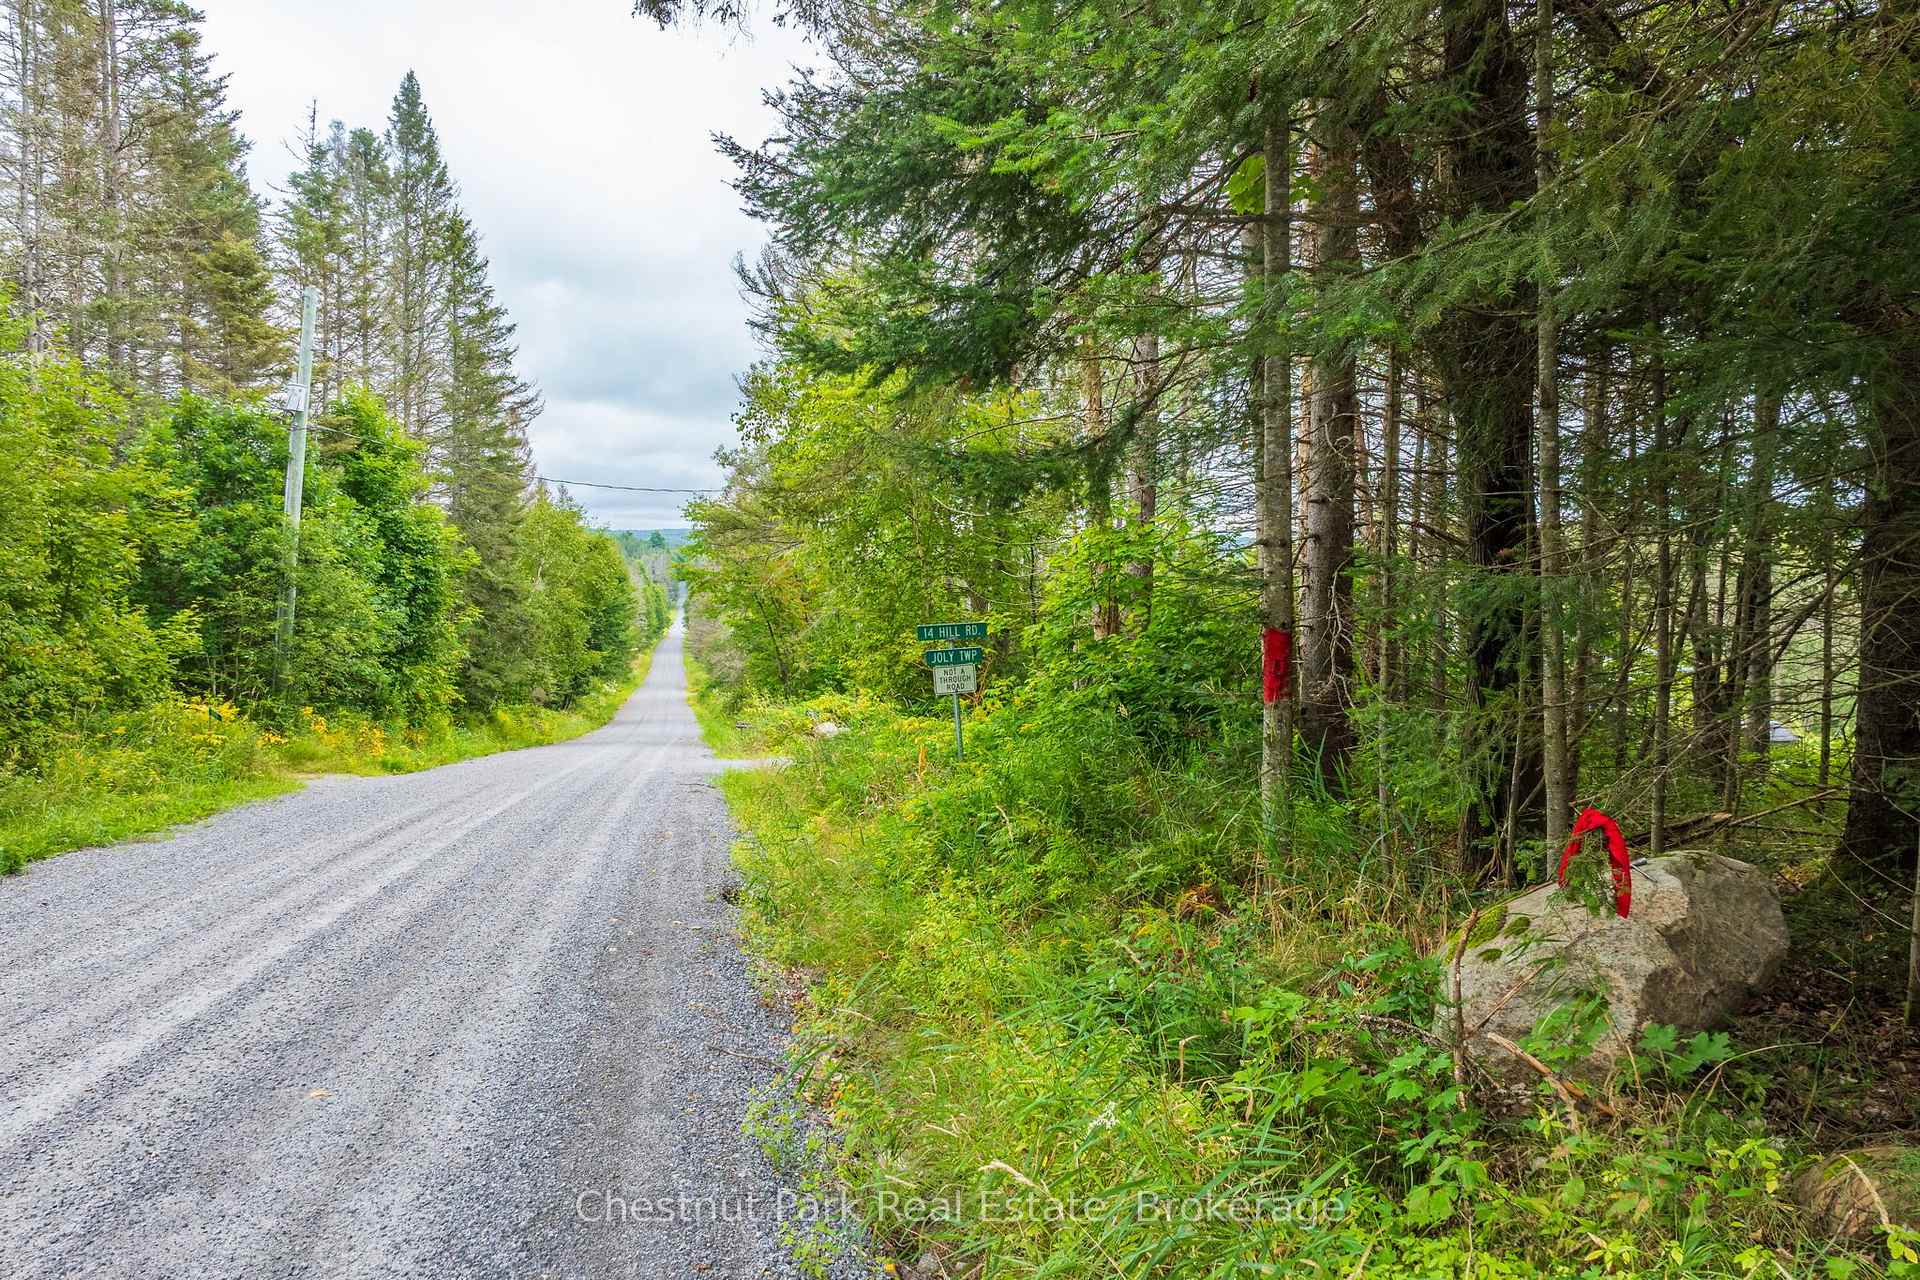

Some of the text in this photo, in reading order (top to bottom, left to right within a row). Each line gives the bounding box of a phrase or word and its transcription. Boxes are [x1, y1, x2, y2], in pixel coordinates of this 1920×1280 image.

[924, 624, 981, 639] 14 HILL RD.
[931, 650, 977, 663] JOLY TWP
[943, 668, 966, 676] NOT A
[939, 676, 971, 684] THROUGH
